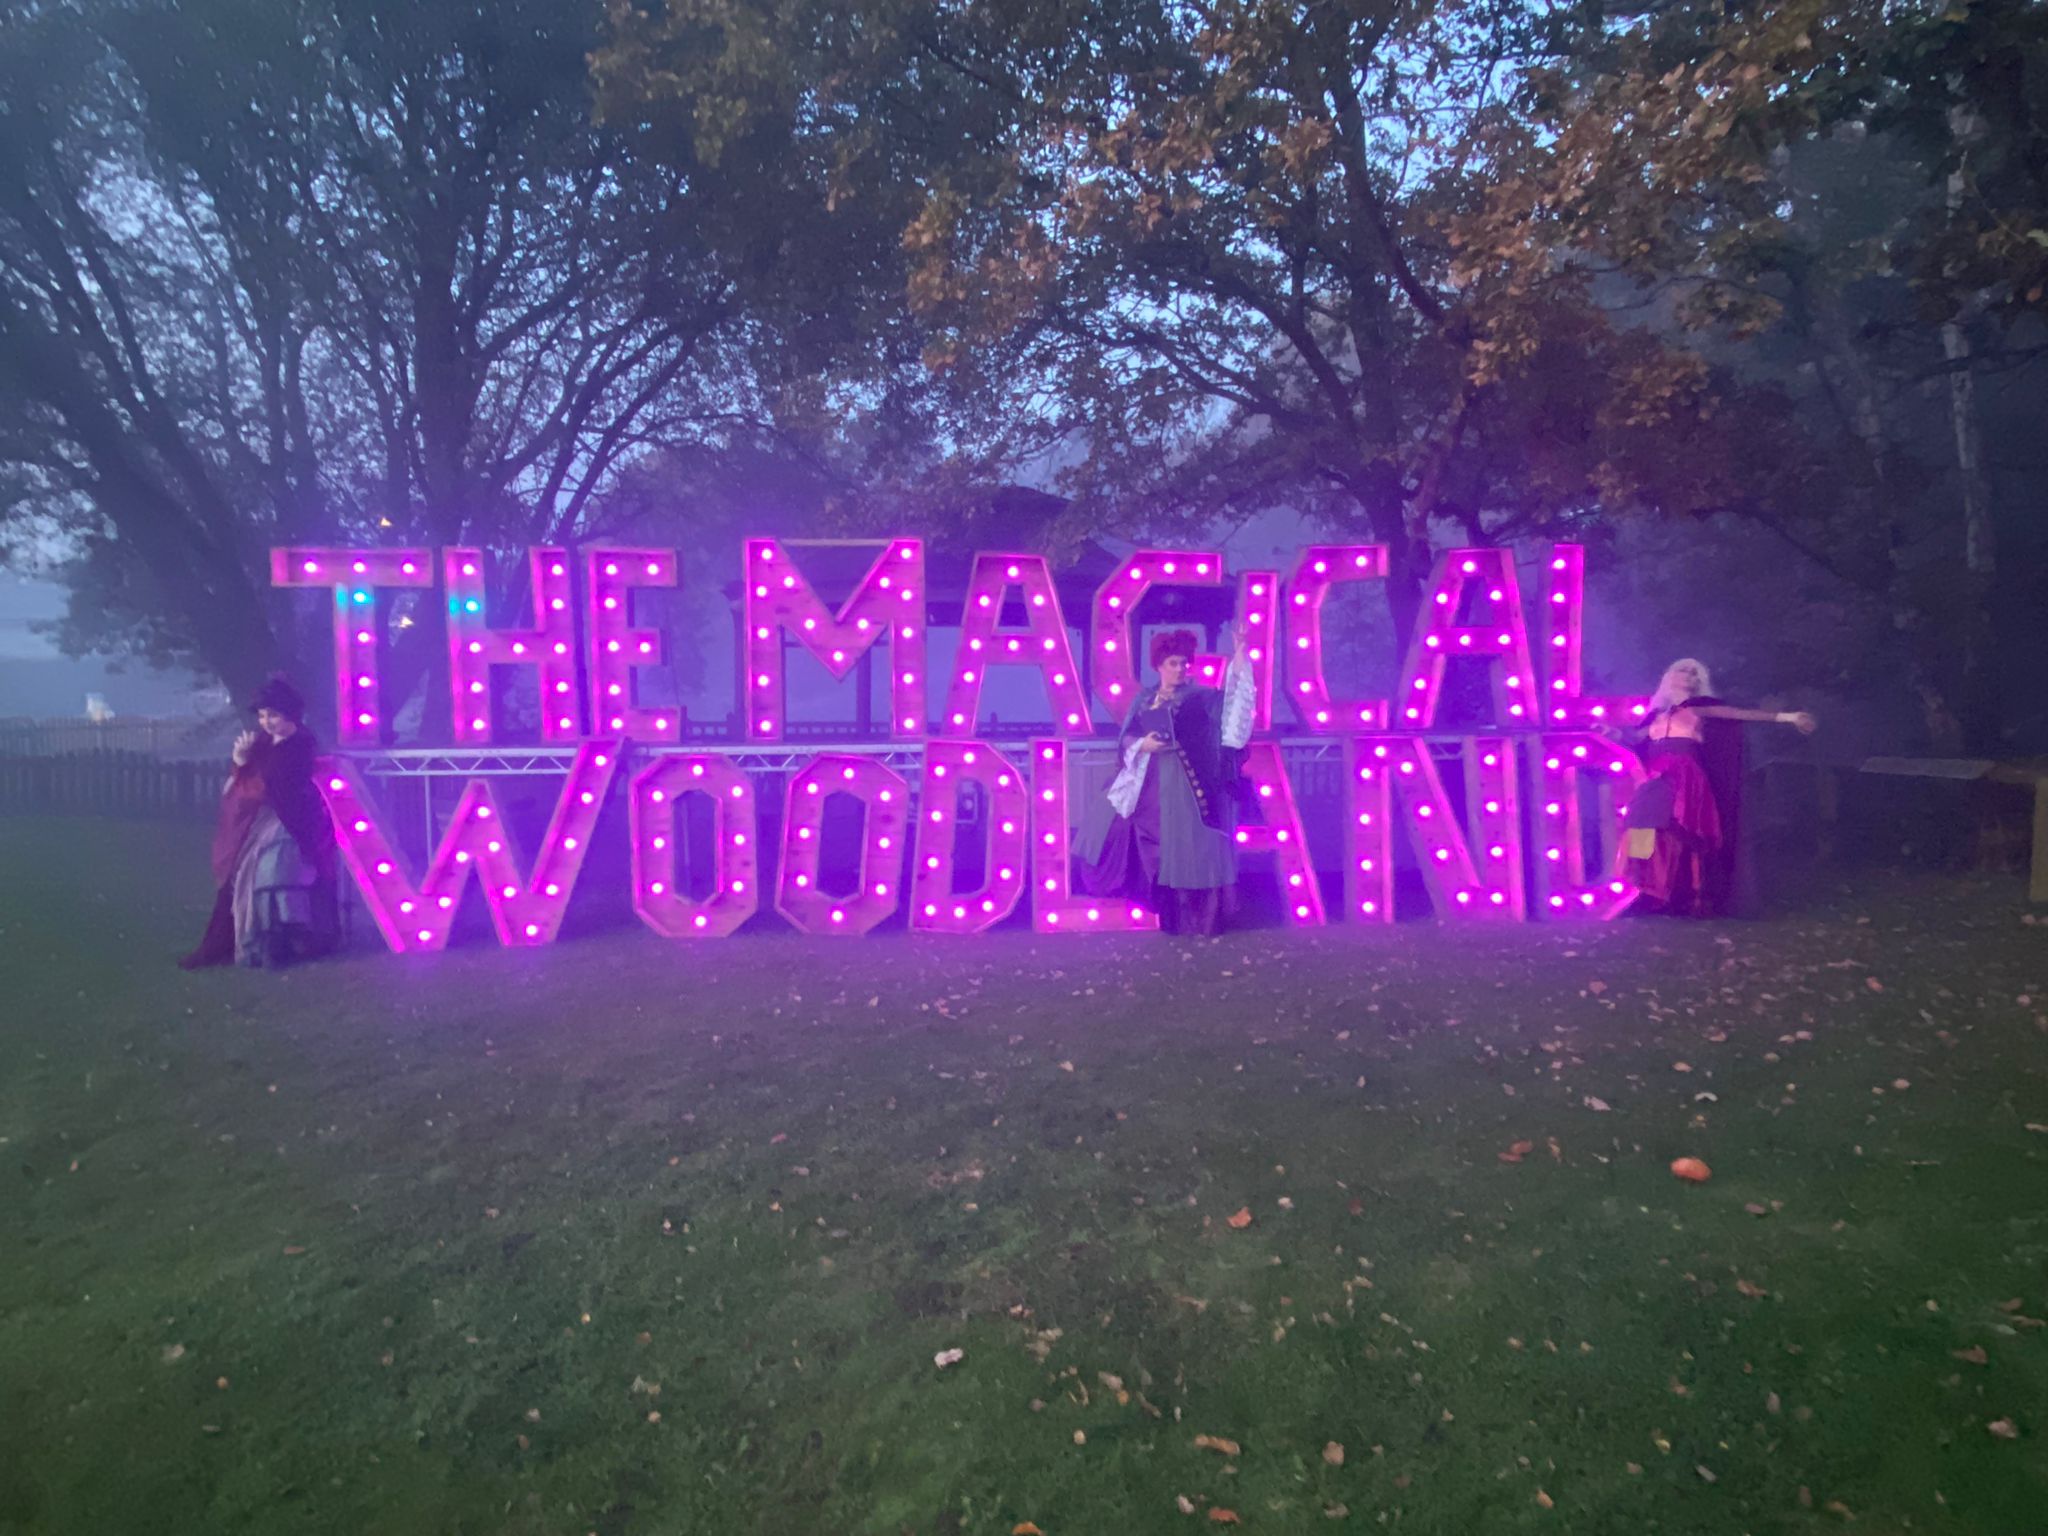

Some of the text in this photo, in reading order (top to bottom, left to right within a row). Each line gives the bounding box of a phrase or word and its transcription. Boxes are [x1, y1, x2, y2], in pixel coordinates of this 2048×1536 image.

[270, 537, 1652, 743] THE MAGICAL
[313, 735, 1645, 952] WOODLAND
